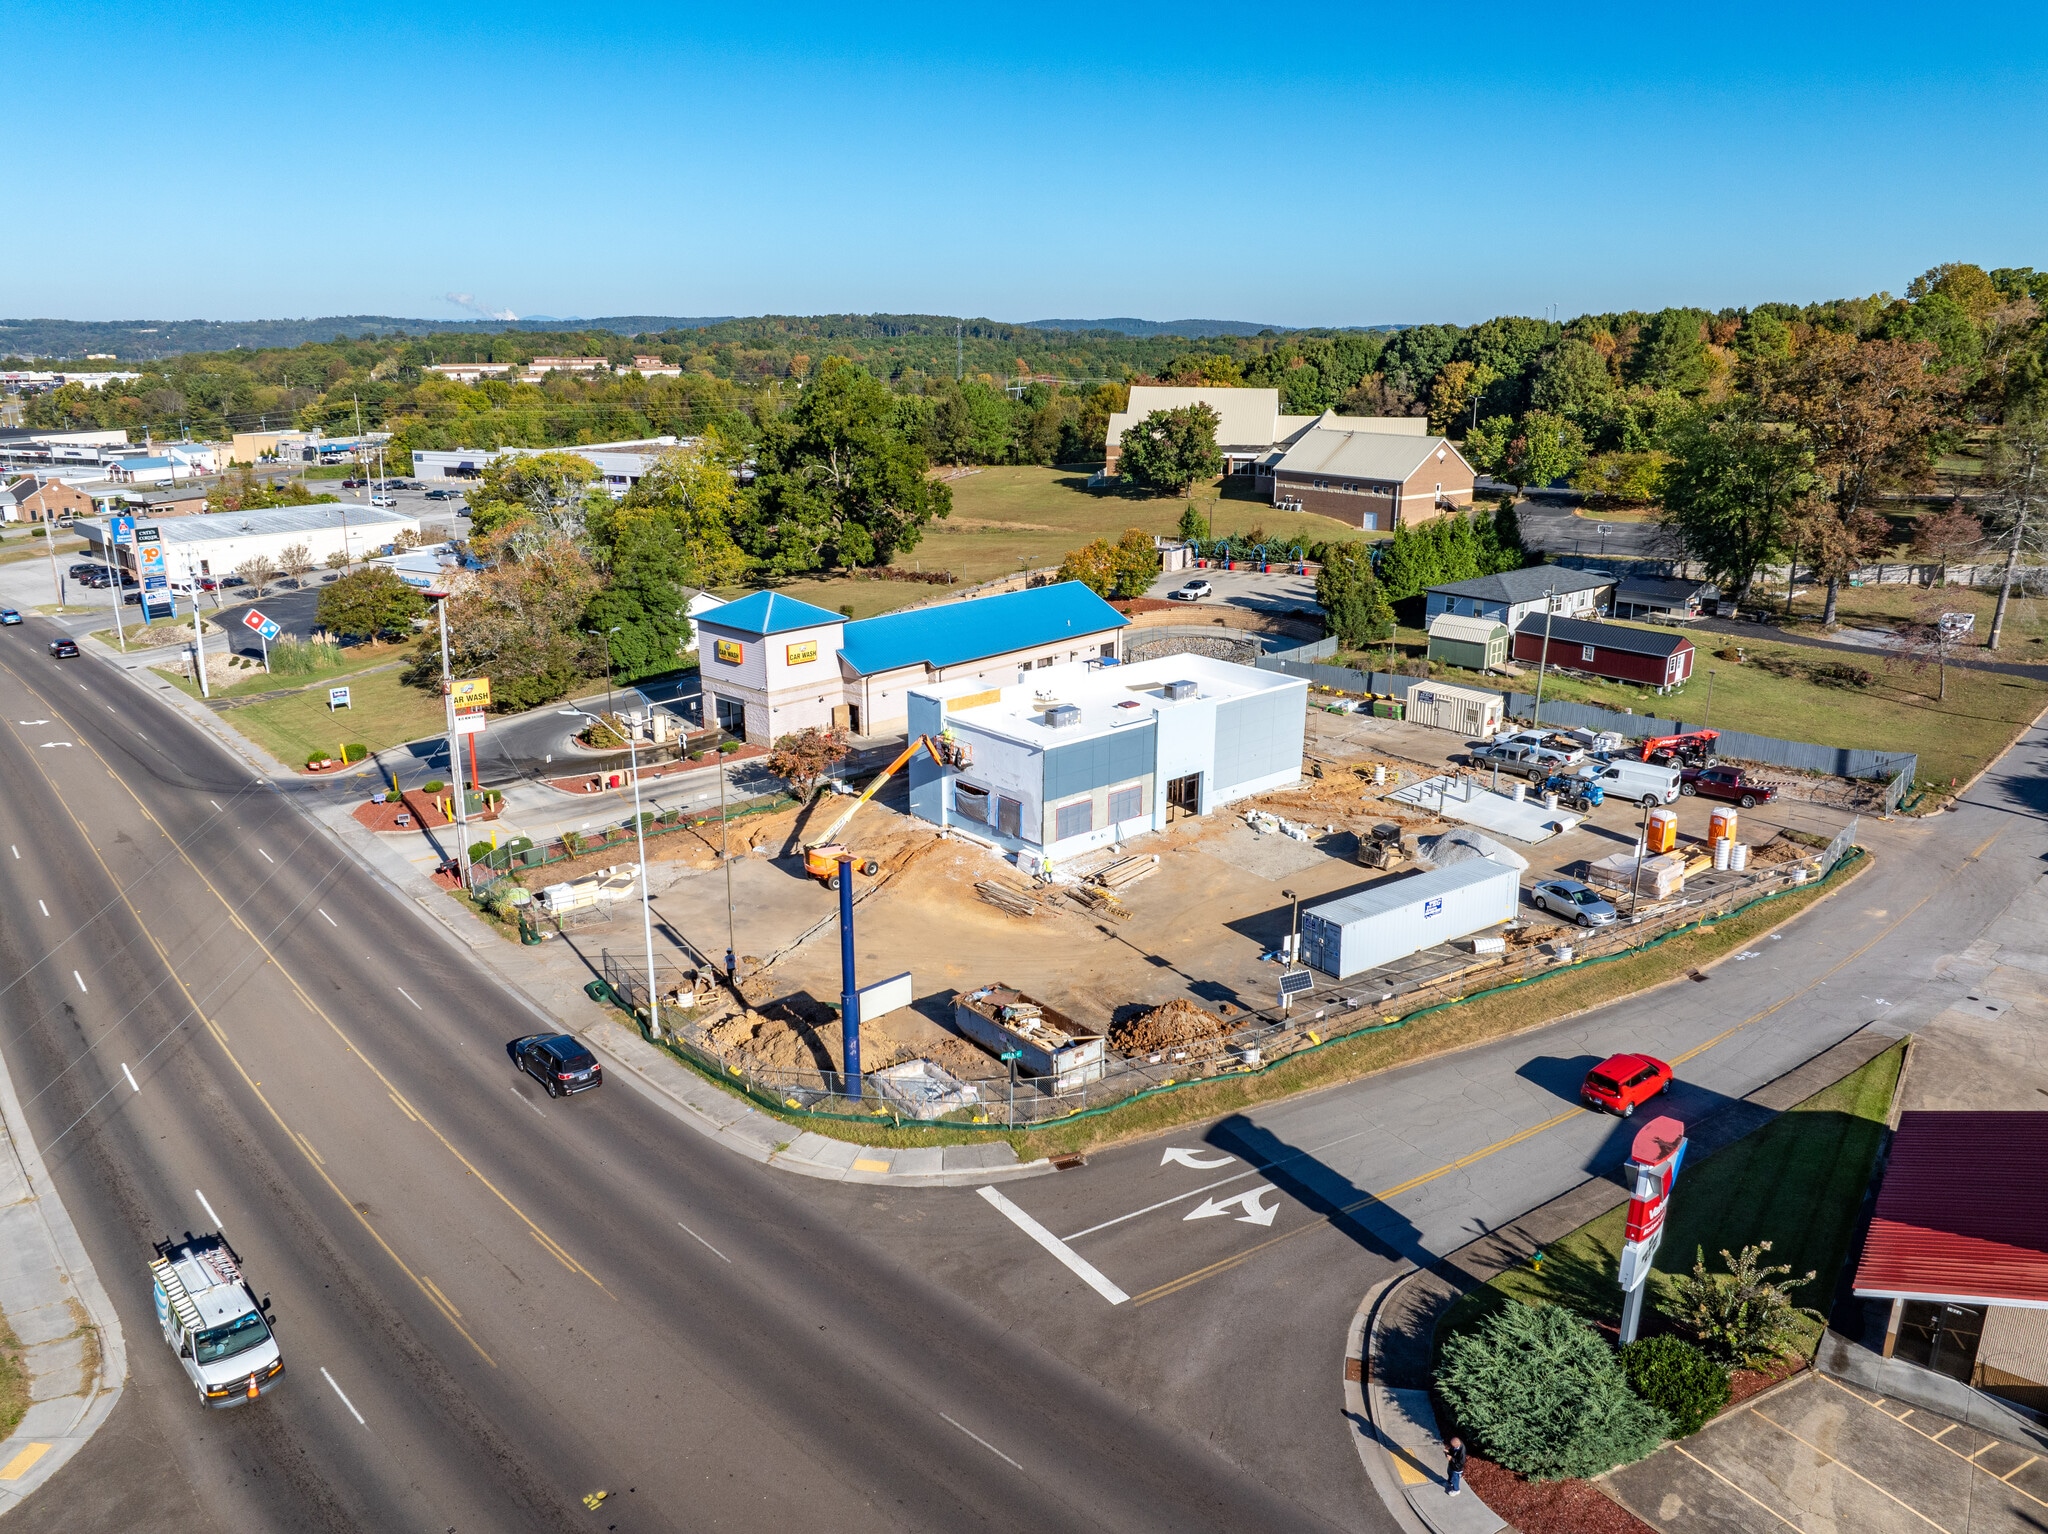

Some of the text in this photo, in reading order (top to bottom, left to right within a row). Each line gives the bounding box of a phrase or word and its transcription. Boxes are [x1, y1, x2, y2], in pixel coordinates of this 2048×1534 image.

[789, 653, 801, 661] CAR
[801, 650, 817, 659] WASH
[453, 692, 489, 704] AR WASH
